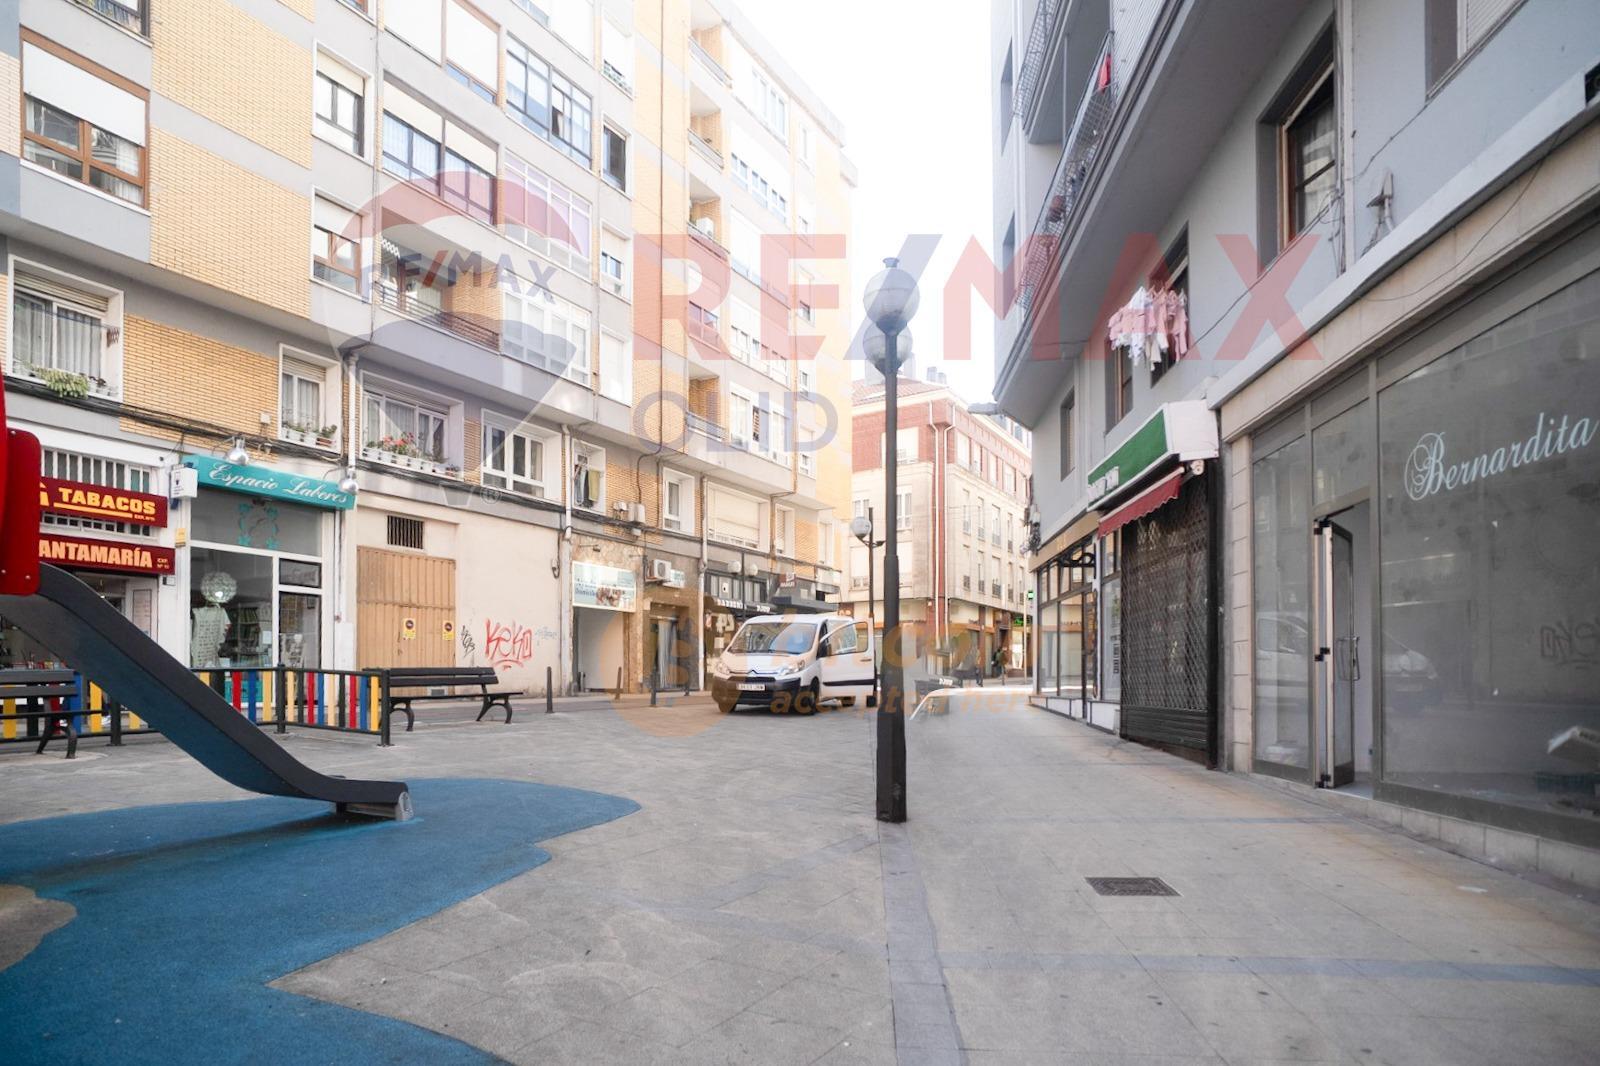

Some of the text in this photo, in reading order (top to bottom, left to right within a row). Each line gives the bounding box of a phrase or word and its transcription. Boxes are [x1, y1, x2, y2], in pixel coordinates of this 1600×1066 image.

[1404, 412, 1600, 500] Bernardita
[58, 486, 156, 515] TABACOS
[209, 461, 347, 503] Espacio Labores
